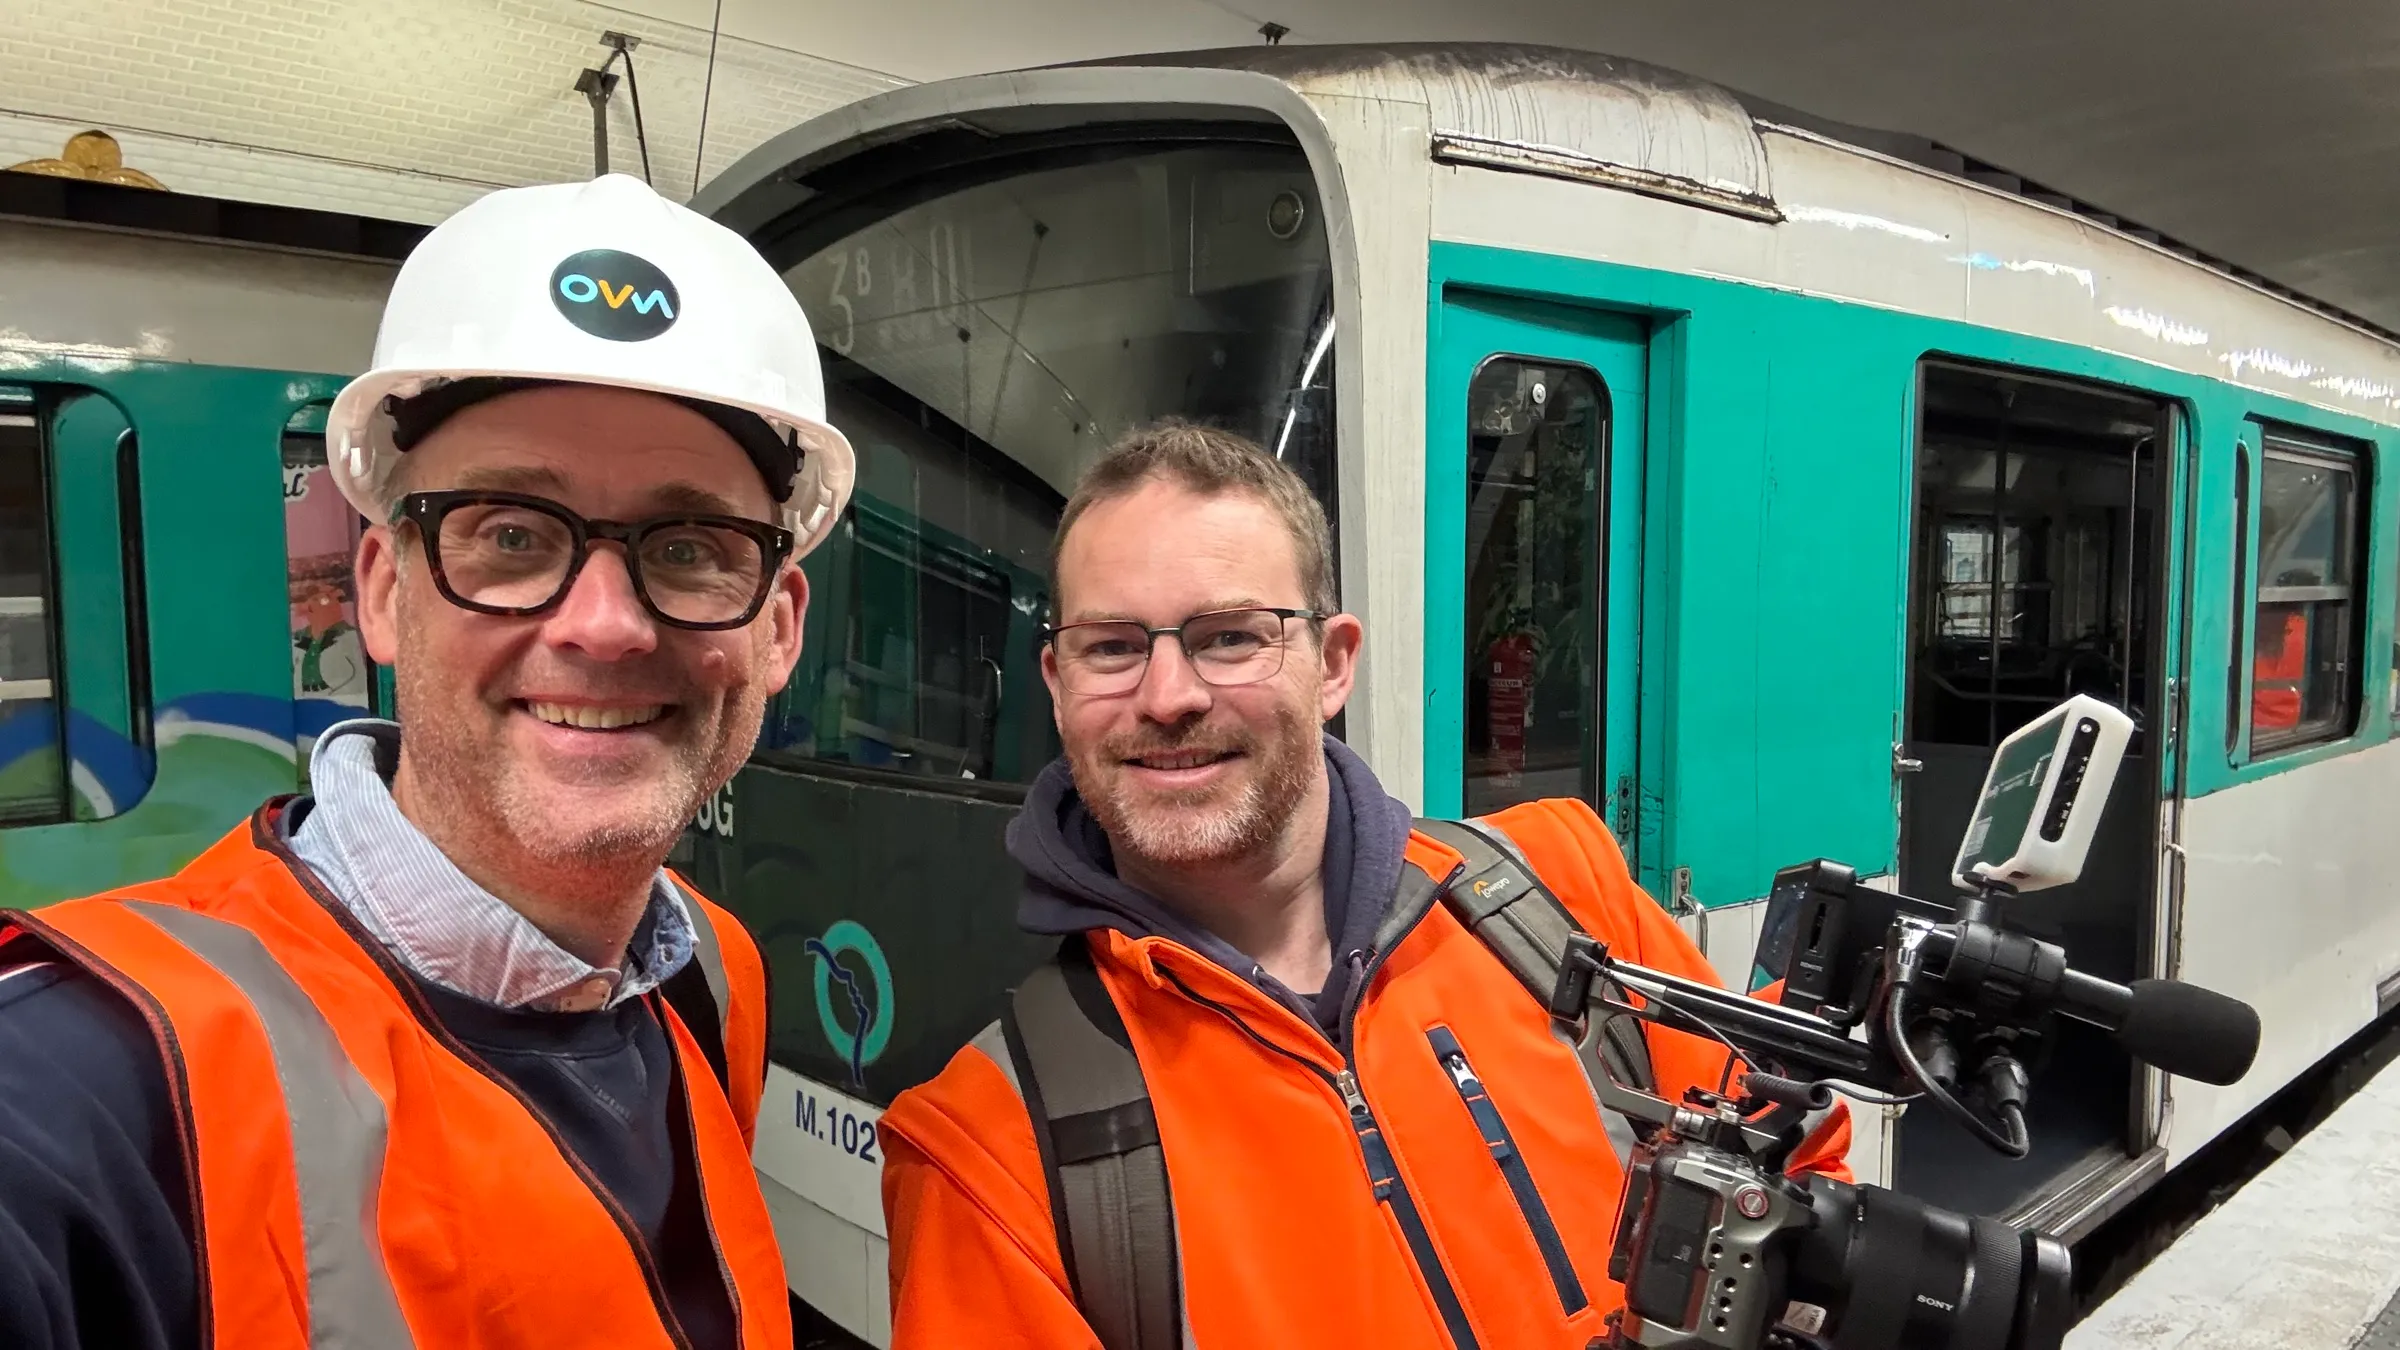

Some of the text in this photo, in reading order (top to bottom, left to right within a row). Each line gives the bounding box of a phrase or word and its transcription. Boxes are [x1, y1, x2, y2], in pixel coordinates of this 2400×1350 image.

[1481, 877, 1510, 899] Lowepro
[796, 1089, 876, 1164] M.102
[1916, 1294, 1954, 1312] SONY
